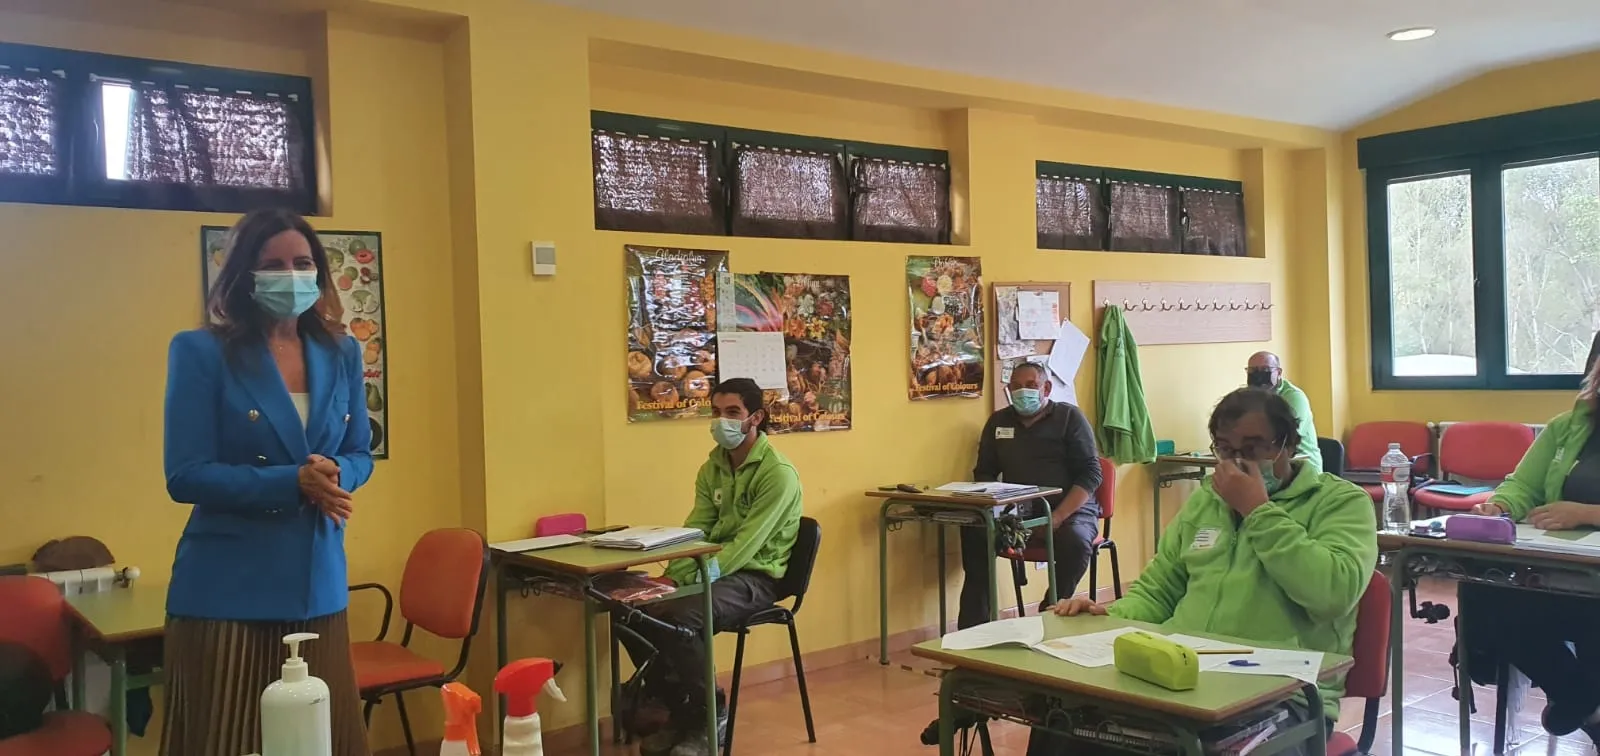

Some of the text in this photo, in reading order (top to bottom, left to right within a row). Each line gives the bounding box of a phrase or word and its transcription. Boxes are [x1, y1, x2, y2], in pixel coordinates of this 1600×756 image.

[915, 383, 941, 392] Festival
[942, 383, 950, 391] of
[637, 398, 711, 410] Festival of Colo
[803, 412, 813, 421] of
